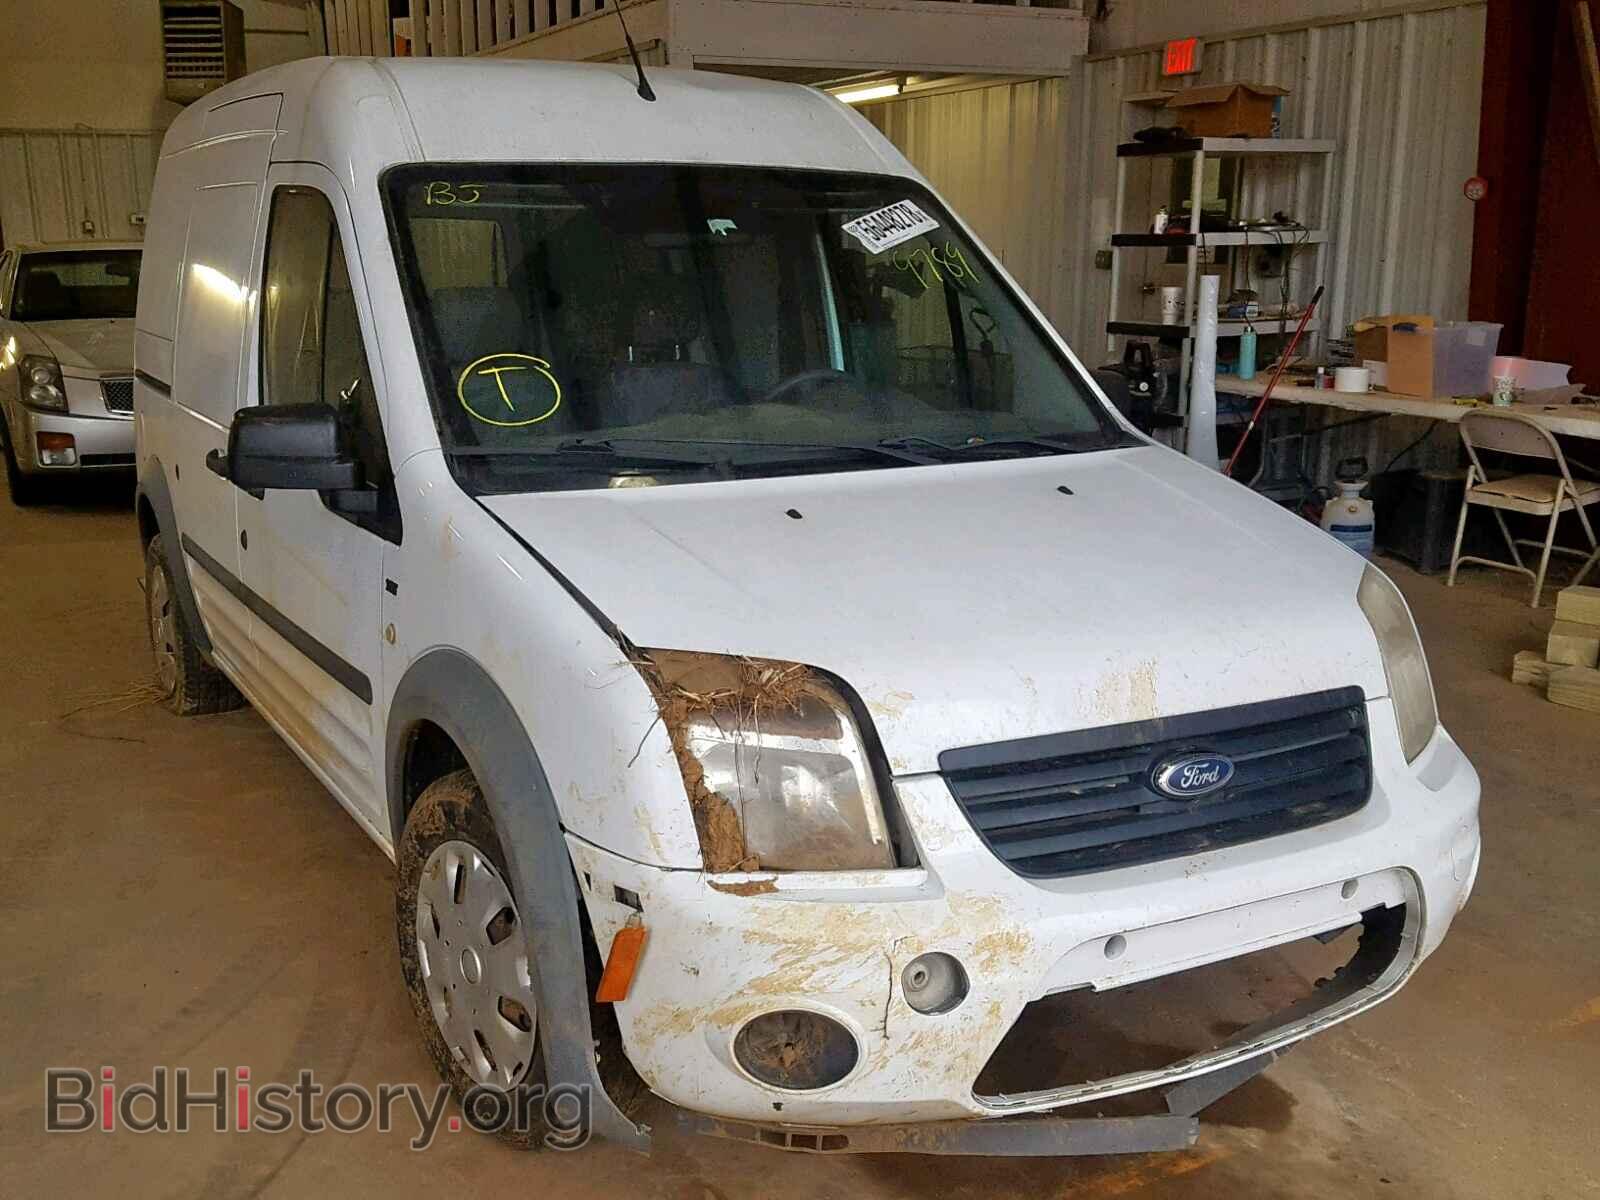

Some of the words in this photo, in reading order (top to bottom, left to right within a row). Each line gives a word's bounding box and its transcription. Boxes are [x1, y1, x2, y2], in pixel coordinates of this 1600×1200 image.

[1167, 39, 1197, 74] EXIT
[855, 203, 924, 241] 56448278
[478, 366, 528, 412] T
[1181, 763, 1220, 788] Ford
